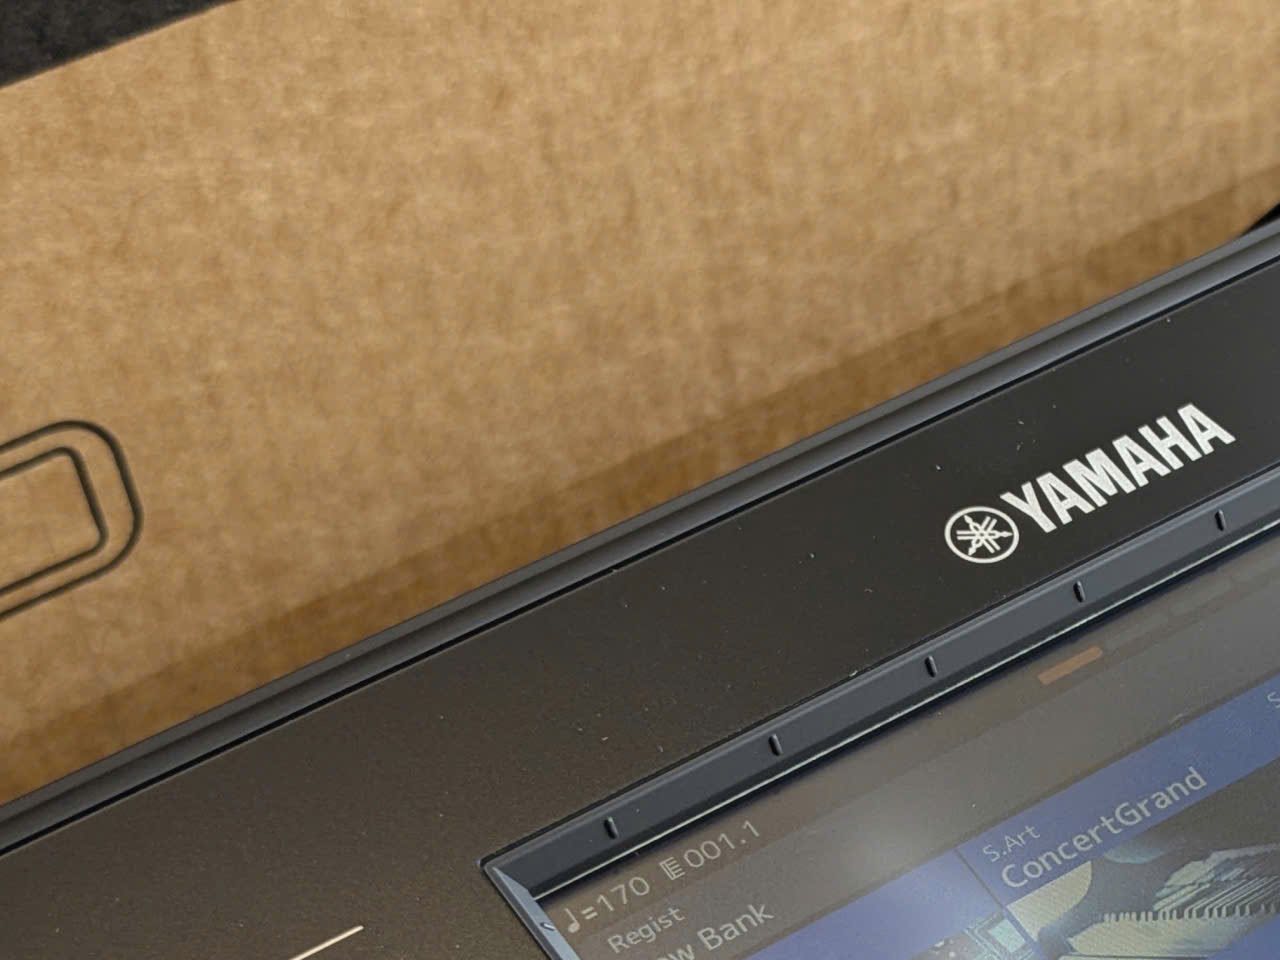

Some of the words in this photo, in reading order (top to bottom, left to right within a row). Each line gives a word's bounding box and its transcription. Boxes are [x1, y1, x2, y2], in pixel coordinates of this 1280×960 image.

[1000, 402, 1236, 533] YAMAHA
[982, 822, 1041, 863] S.Art
[1001, 766, 1208, 889] ConcertGrand
[607, 905, 685, 953] Regist
[697, 904, 774, 951] Bank
